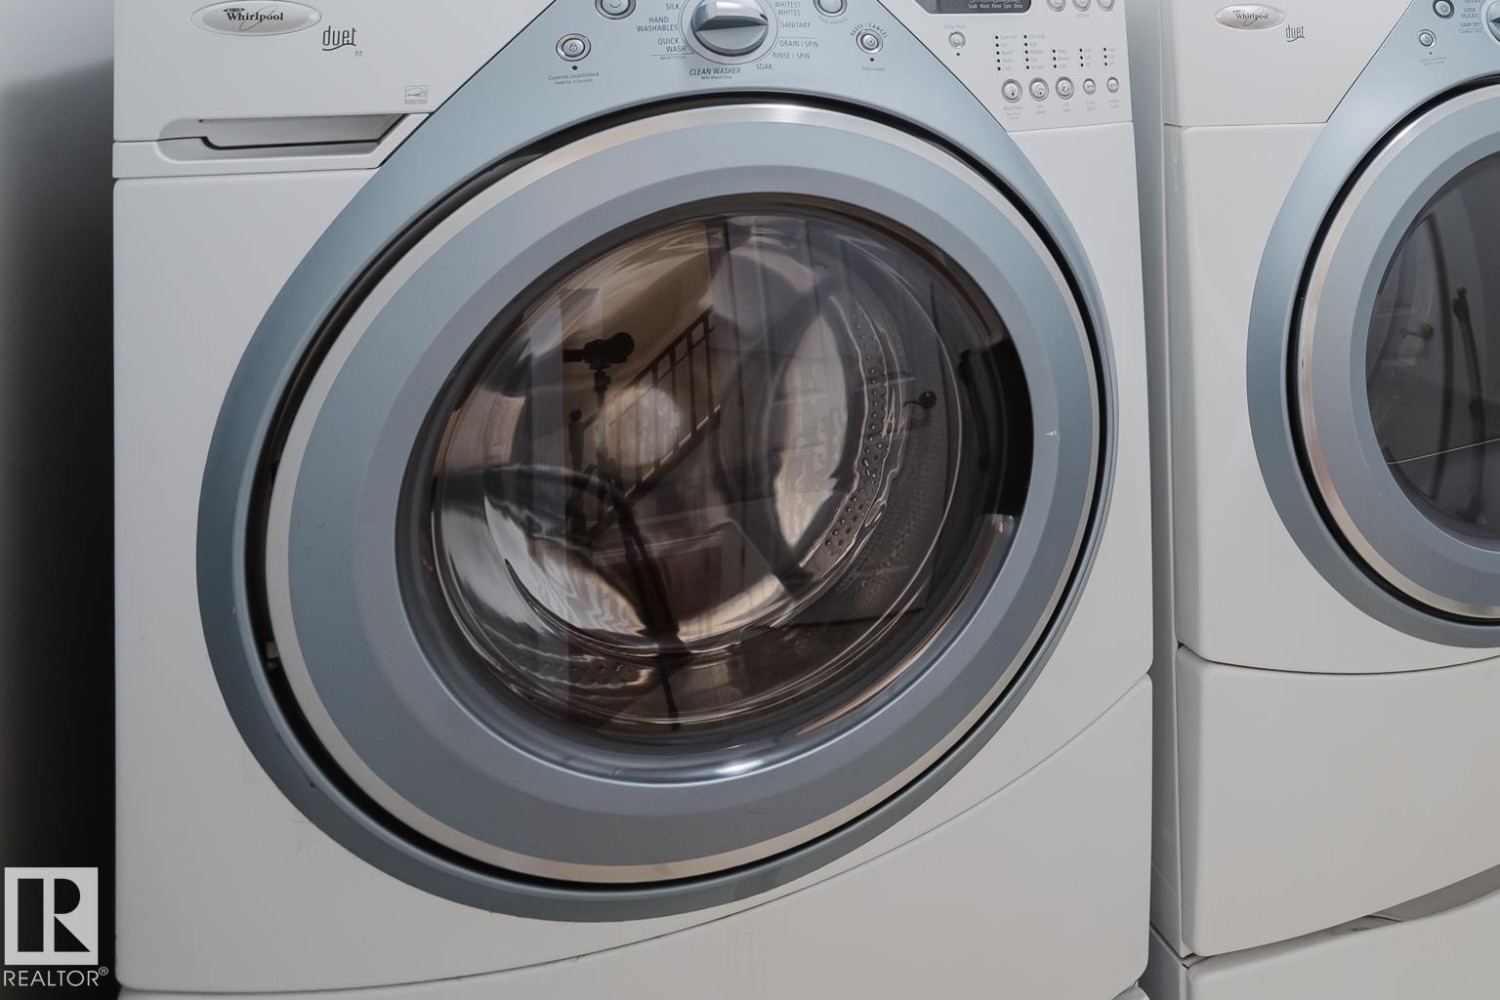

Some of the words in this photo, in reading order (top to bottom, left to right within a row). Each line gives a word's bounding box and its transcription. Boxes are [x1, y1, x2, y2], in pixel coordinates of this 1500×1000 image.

[226, 11, 284, 25] Whirlpool
[1235, 12, 1269, 22] Whirlpool
[636, 23, 679, 32] WASHABLES
[322, 25, 358, 51] duet
[1285, 24, 1306, 43] duet
[657, 37, 680, 45] QUICK
[689, 68, 712, 76] CLEAN
[712, 67, 741, 75] WASHER
[755, 63, 773, 71] SOAK
